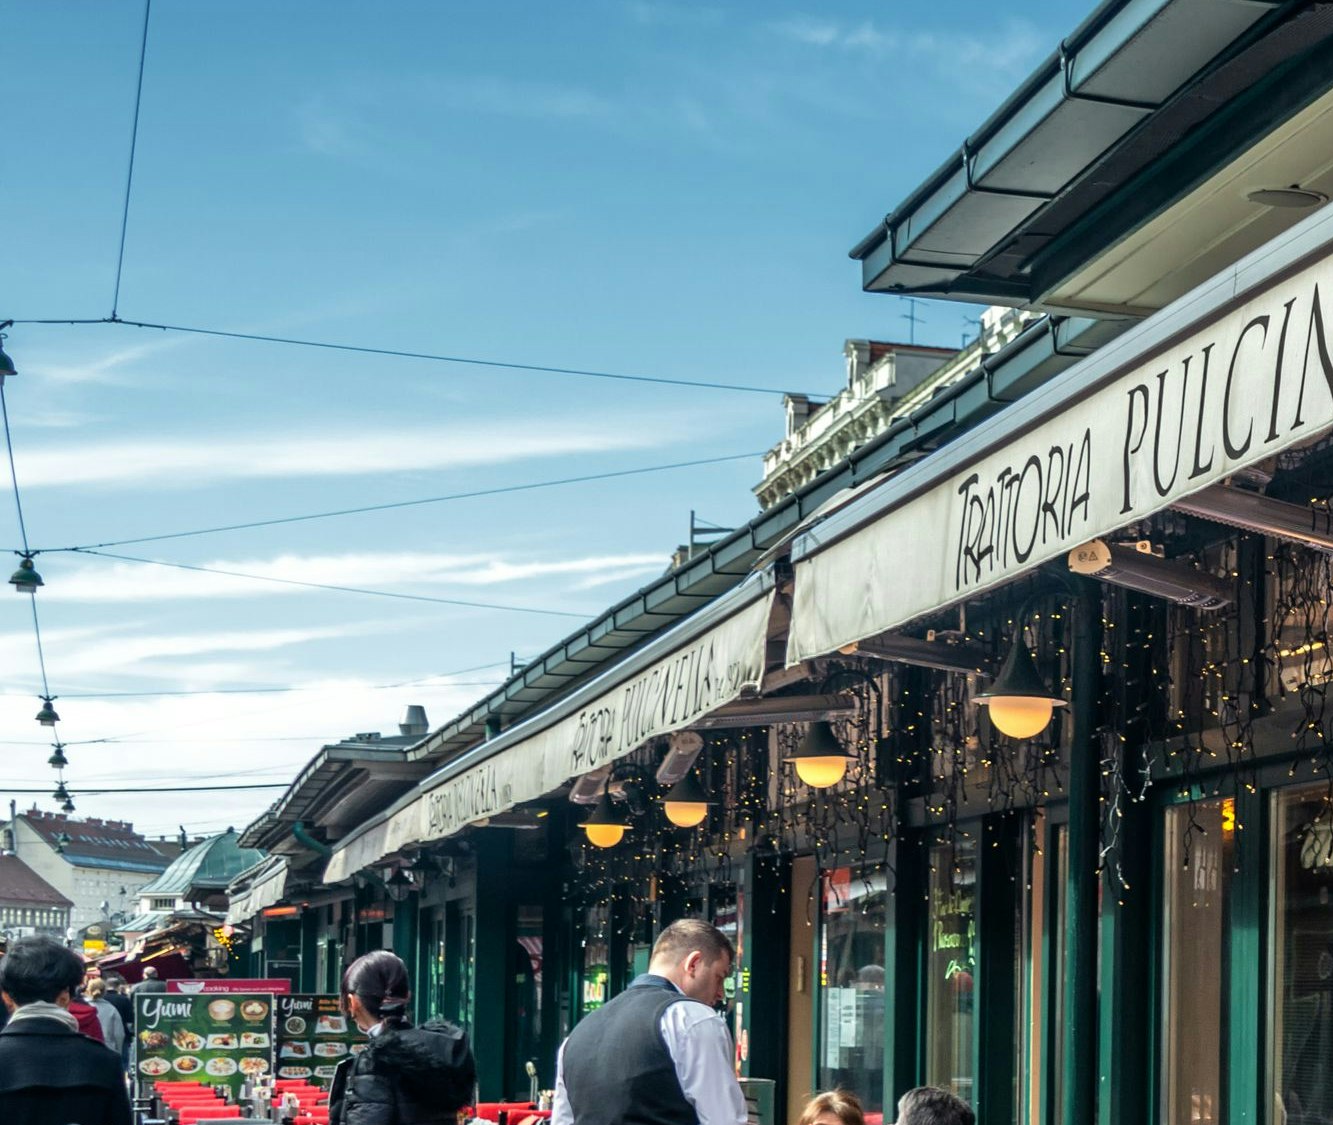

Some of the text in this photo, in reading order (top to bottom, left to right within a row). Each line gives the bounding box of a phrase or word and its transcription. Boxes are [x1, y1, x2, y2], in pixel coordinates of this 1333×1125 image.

[955, 427, 1093, 592] TRATTORIA
[142, 998, 192, 1029] Yumi
[281, 998, 313, 1017] Yumi
